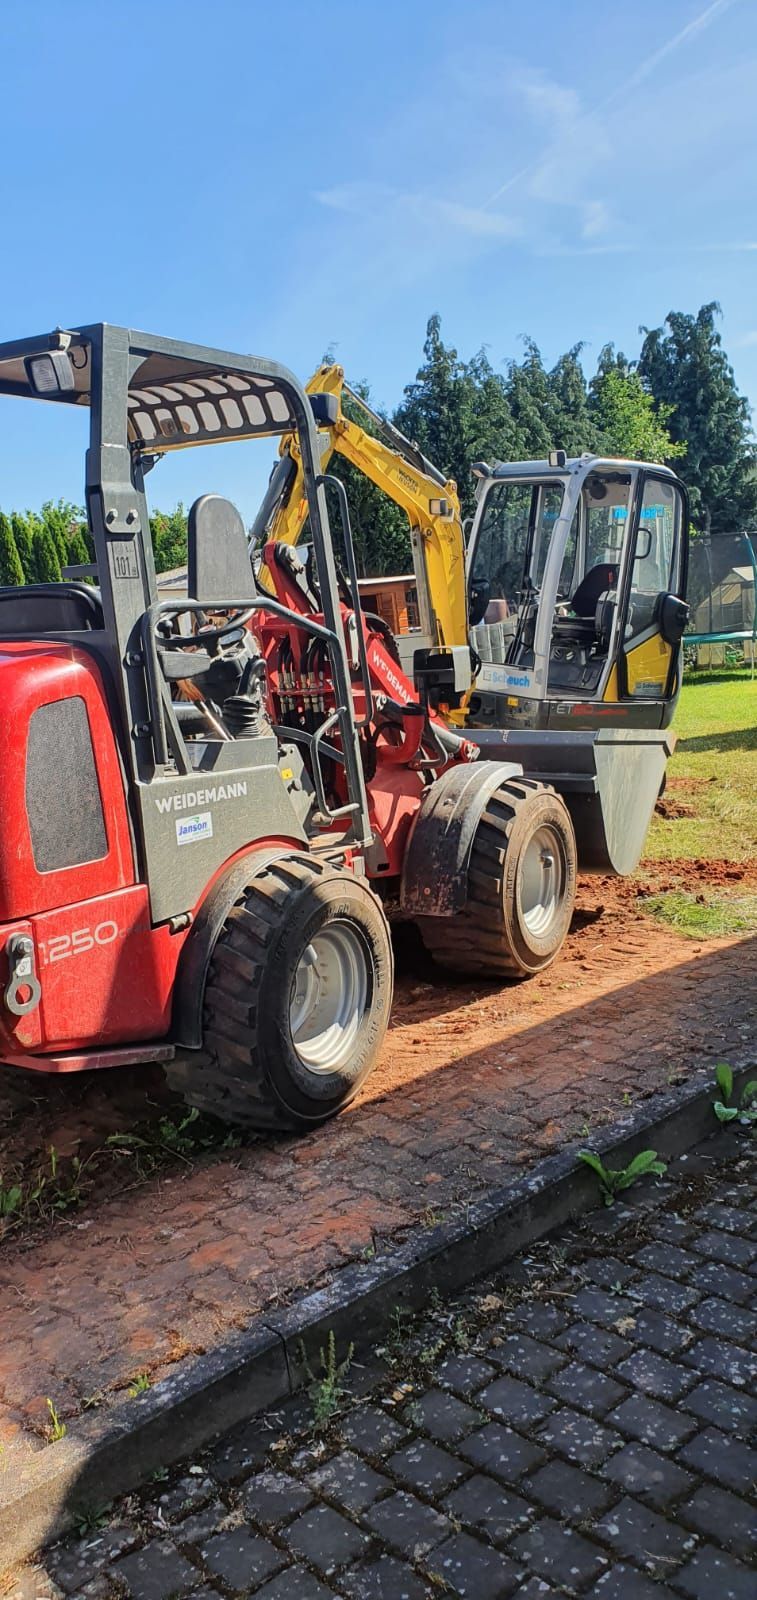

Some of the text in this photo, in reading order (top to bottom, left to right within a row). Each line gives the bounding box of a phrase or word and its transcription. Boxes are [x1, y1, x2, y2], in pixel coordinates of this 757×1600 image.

[116, 556, 131, 576] 101
[155, 782, 247, 813] WEIDEMANN
[178, 821, 208, 836] Janson
[38, 920, 119, 965] 1250
